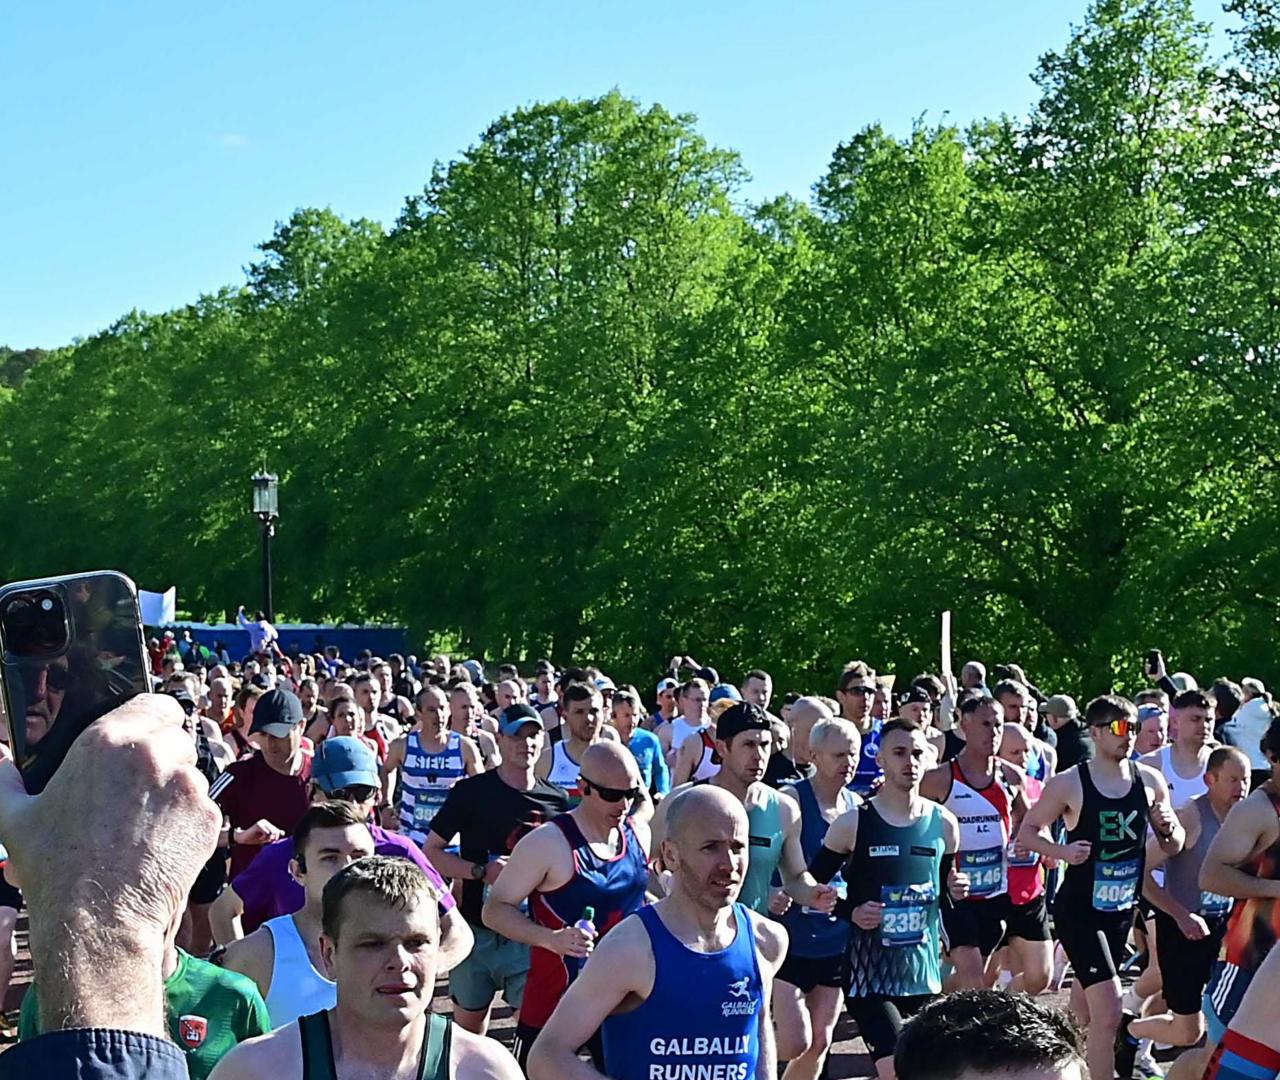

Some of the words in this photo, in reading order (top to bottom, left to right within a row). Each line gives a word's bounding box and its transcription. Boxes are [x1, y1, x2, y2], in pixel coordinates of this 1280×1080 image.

[958, 814, 1000, 824] OADRUNNE
[1099, 810, 1138, 841] EK
[650, 1035, 750, 1056] GALBALLY
